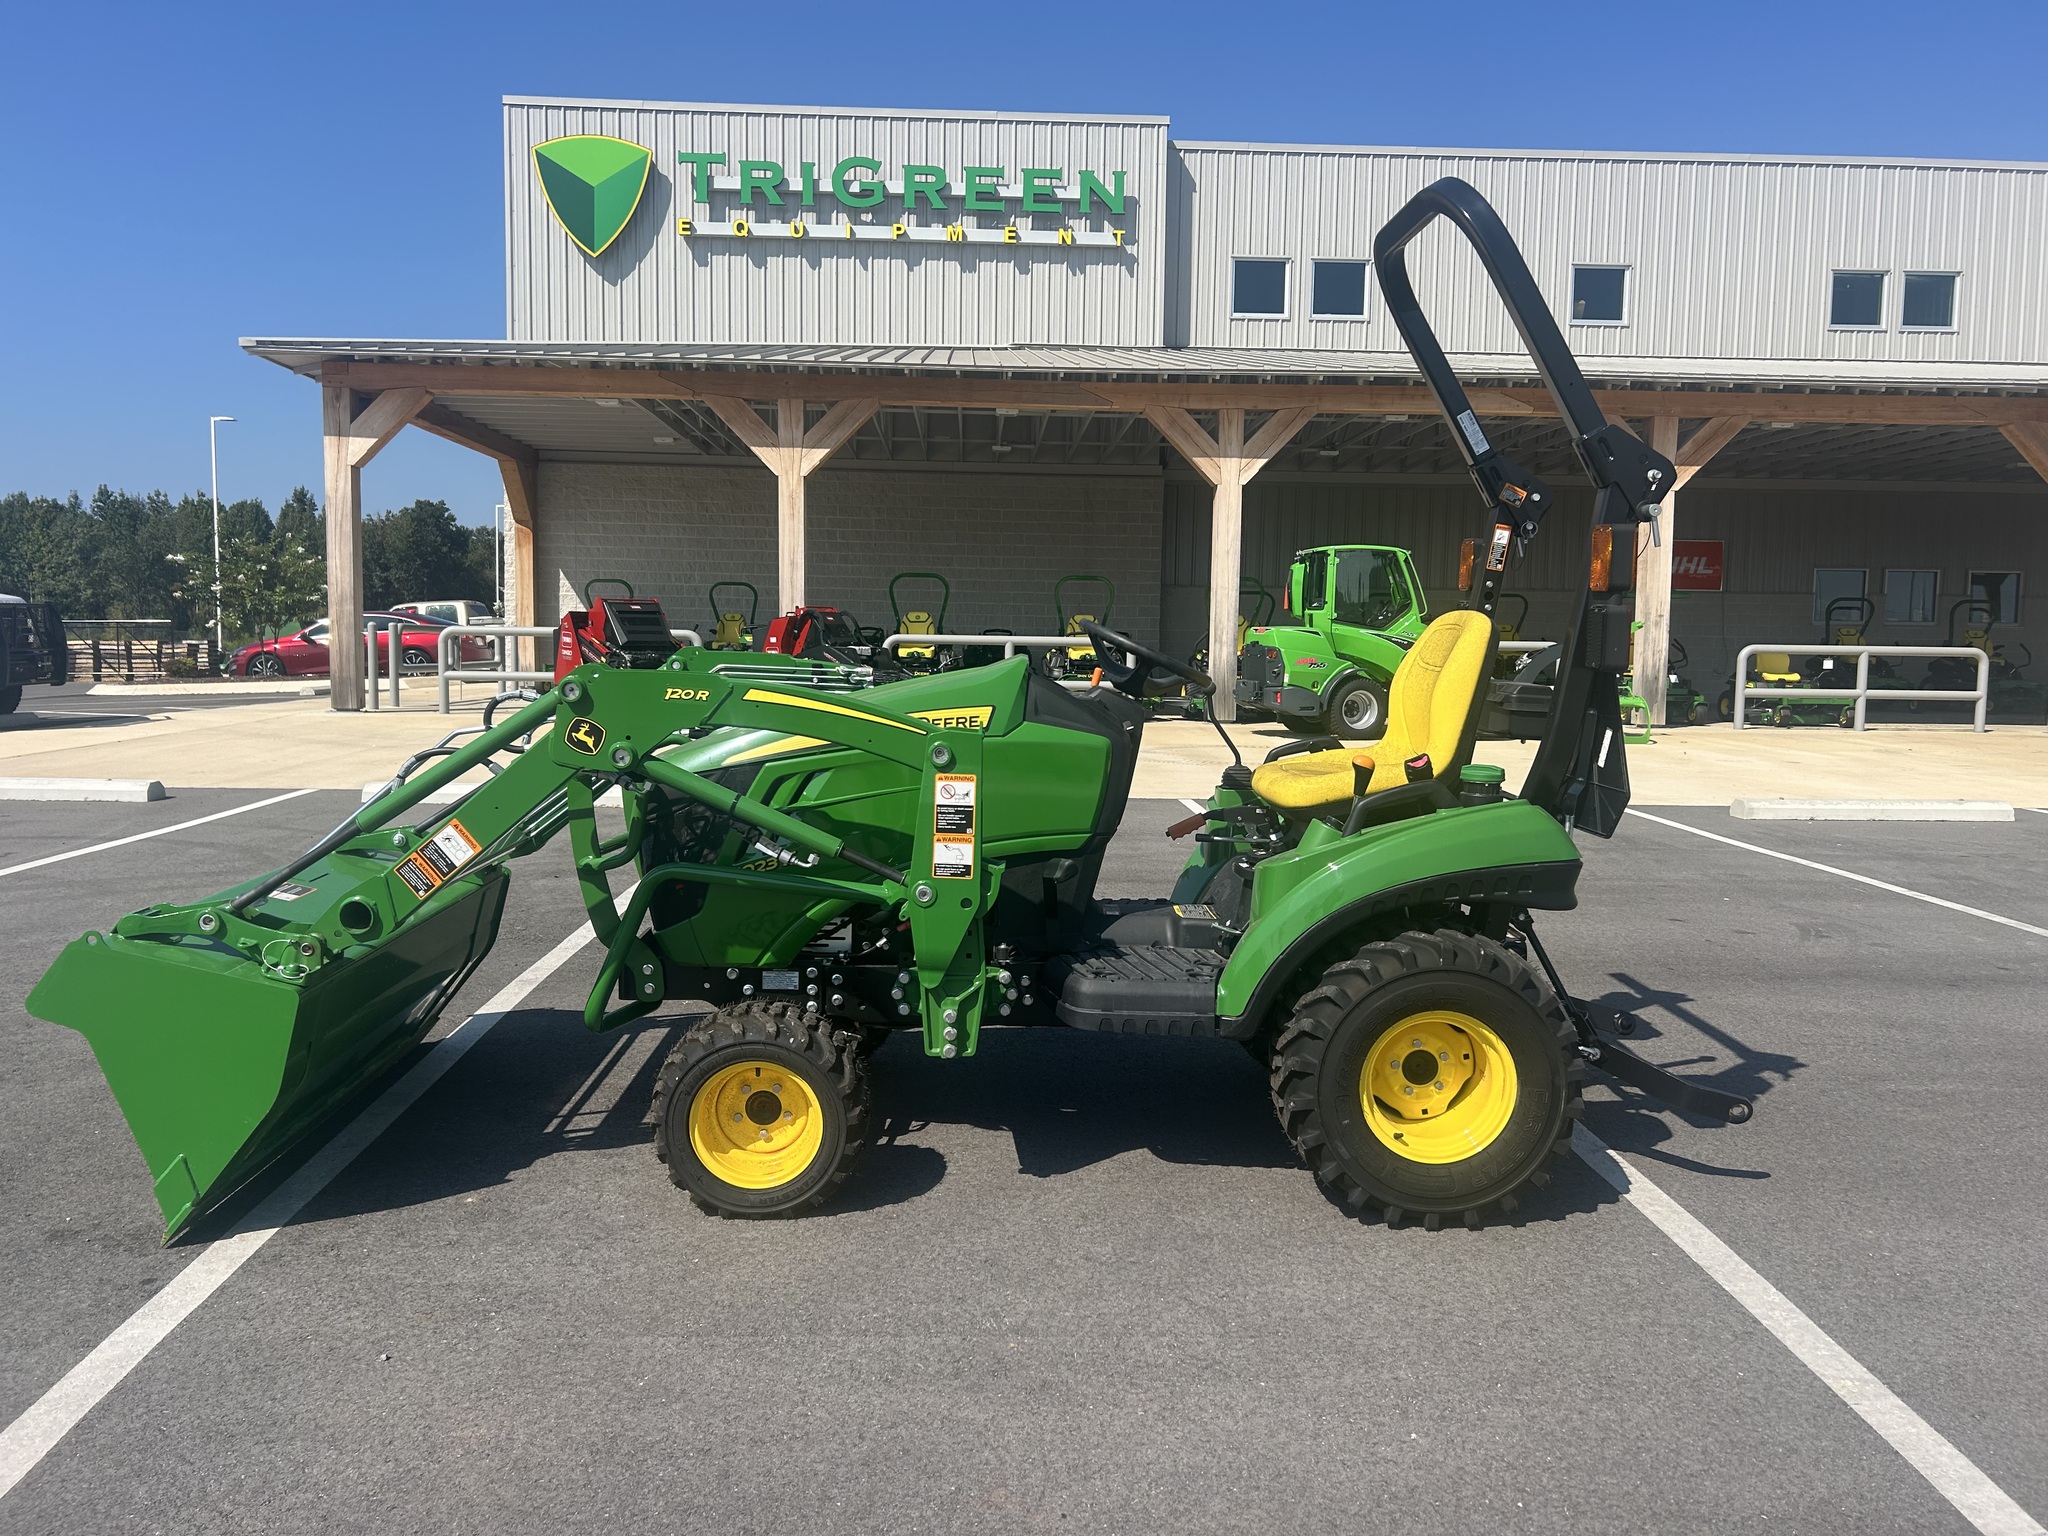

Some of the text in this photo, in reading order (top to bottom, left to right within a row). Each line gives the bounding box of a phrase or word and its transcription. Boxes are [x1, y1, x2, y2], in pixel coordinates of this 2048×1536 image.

[677, 150, 1127, 215] TRIGREEN
[677, 218, 1126, 247] EQUIPMENT
[1672, 556, 1713, 574] IHL
[458, 827, 478, 850] WARNING
[418, 861, 438, 883] WARNING
